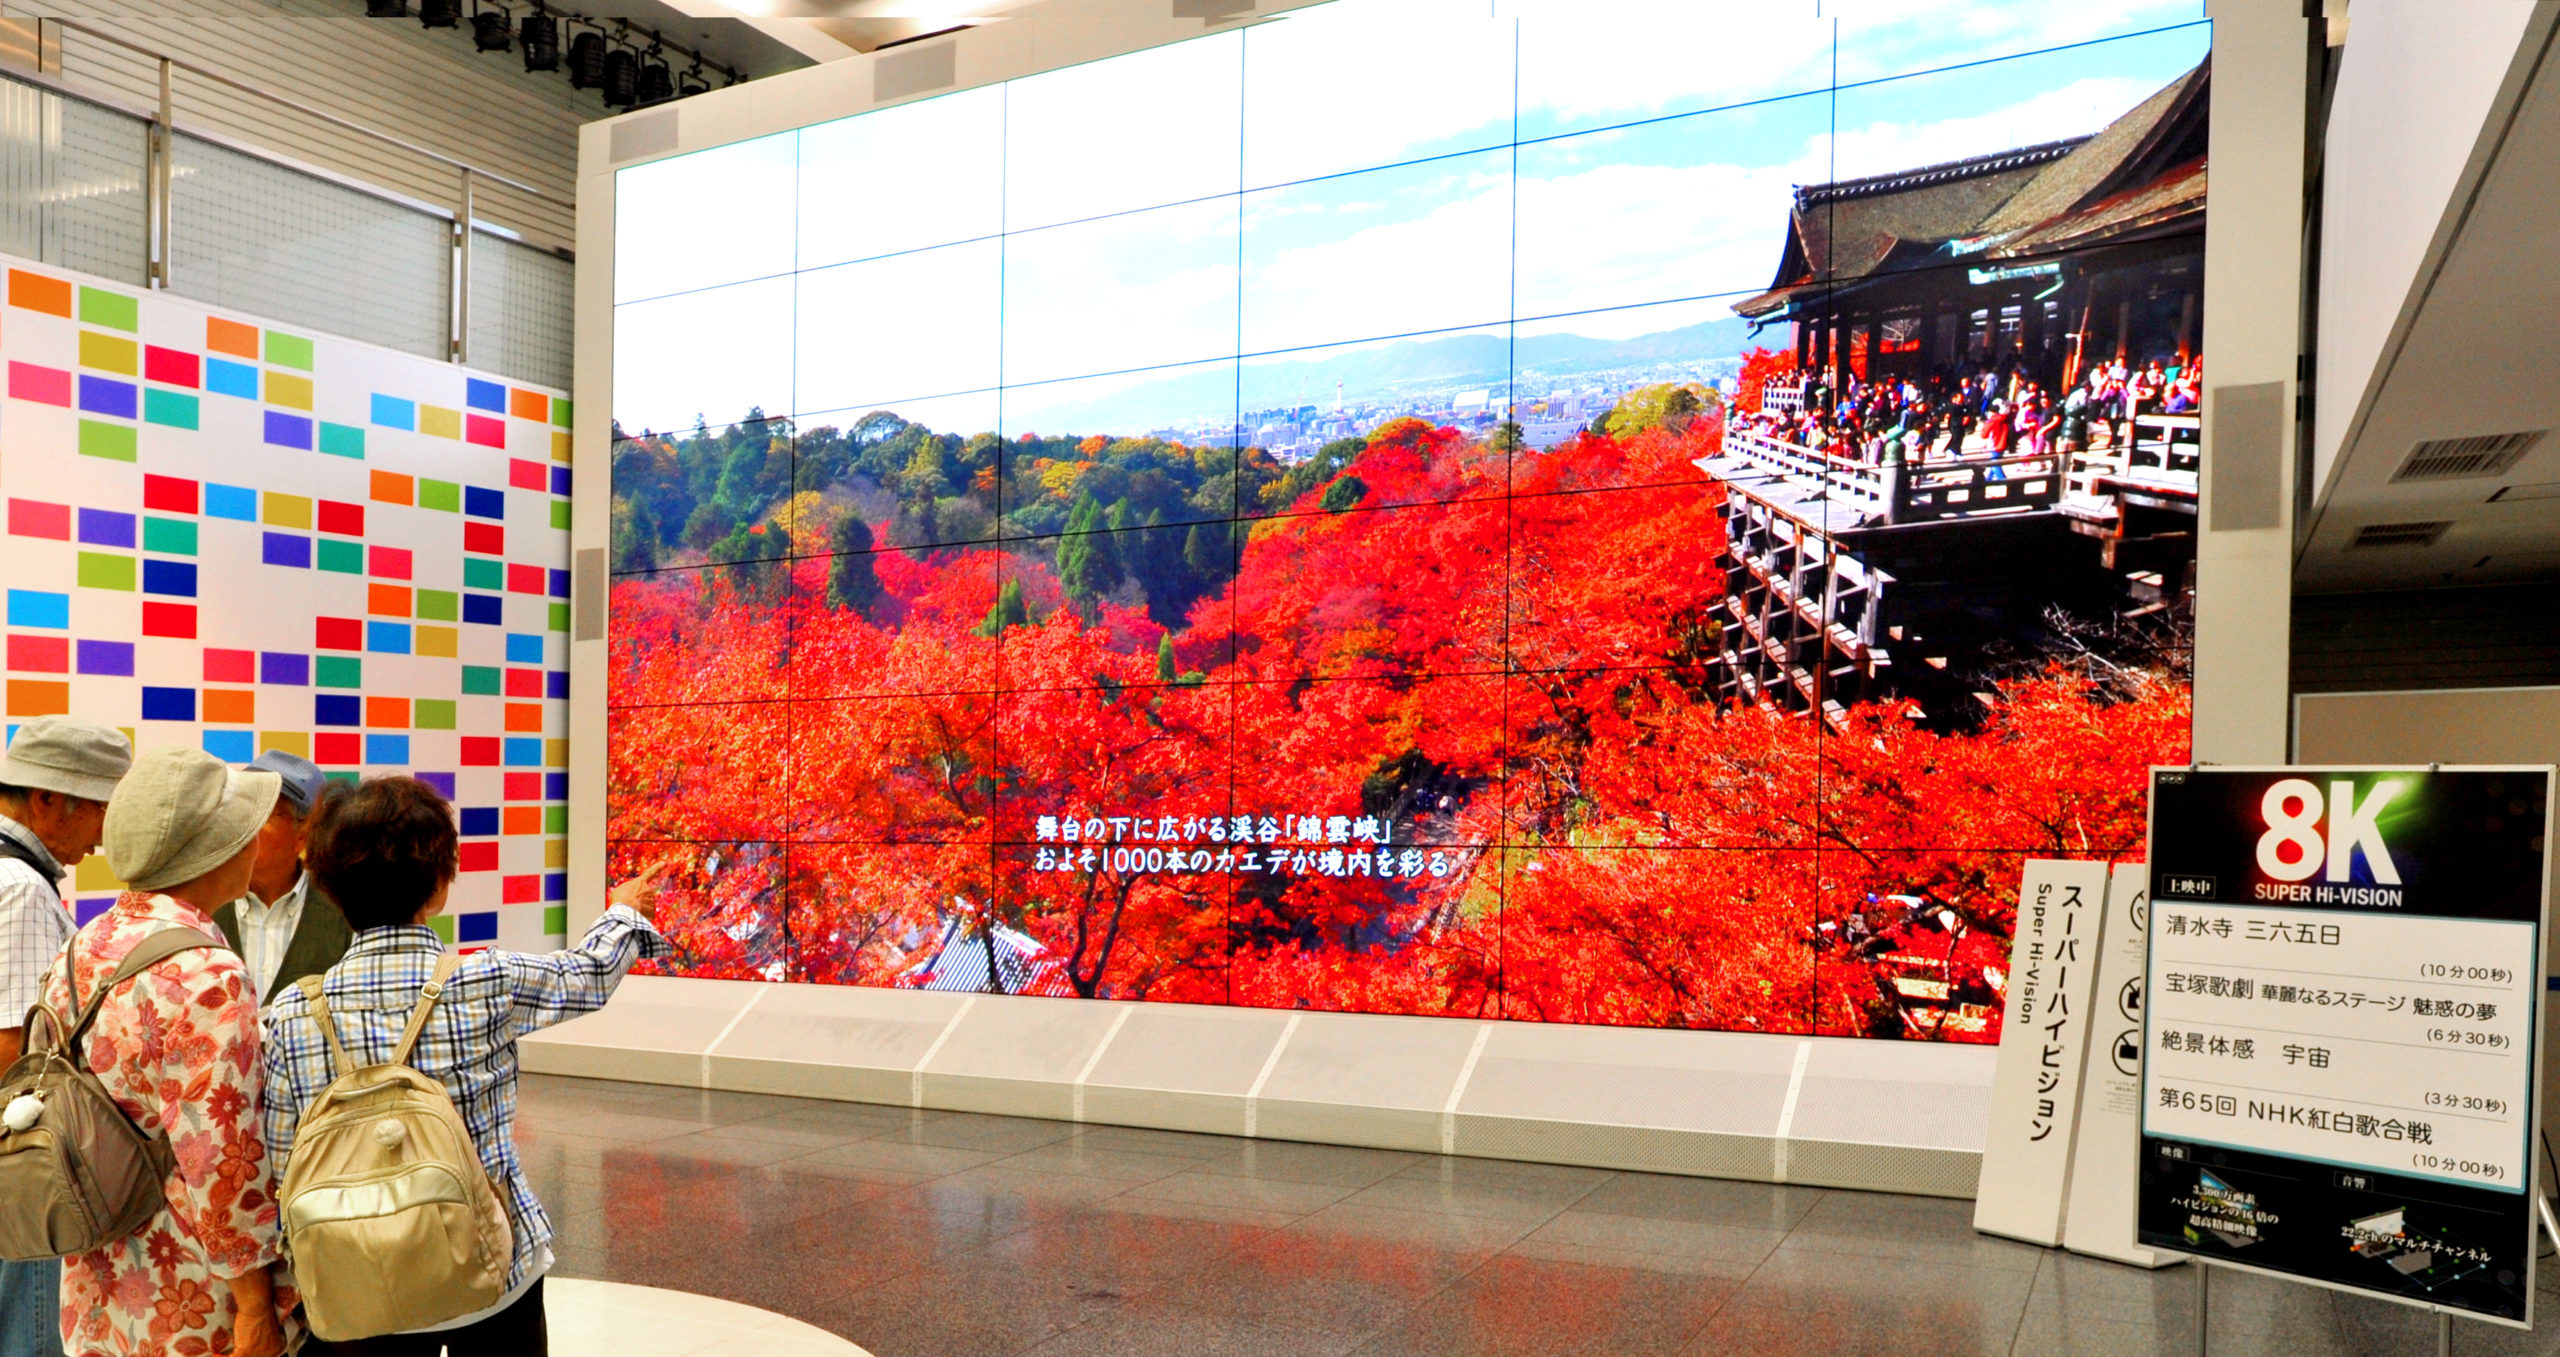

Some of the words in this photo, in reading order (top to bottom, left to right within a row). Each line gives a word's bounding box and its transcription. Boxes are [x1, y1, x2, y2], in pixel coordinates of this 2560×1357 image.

[1035, 814, 1393, 844] 舞台の下に広がる渓谷「錦雲峡」
[2256, 778, 2402, 885] 8K
[1035, 846, 1449, 878] およそ1000本のカエデが境内を彩る
[2167, 878, 2211, 896] 上映中
[2254, 882, 2311, 903] SUPER
[2315, 886, 2402, 907] Hi-VISION
[2032, 883, 2052, 937] Super
[2166, 914, 2234, 939] 清水寺
[2245, 920, 2341, 946] 三六五日
[2020, 942, 2044, 1025] Hi-Vision
[2165, 972, 2254, 1000] 宝塚歌劇
[2261, 984, 2406, 1013] 華麗なるステージ
[2412, 997, 2498, 1021] 魅惑の夢
[2030, 885, 2083, 1141] スーパーハイビジョン
[2161, 1030, 2255, 1060] 絶景体感
[2282, 1044, 2331, 1069] 宇宙
[2159, 1088, 2237, 1117] 第65回
[2248, 1100, 2433, 1145] NHK紅白歌合戦
